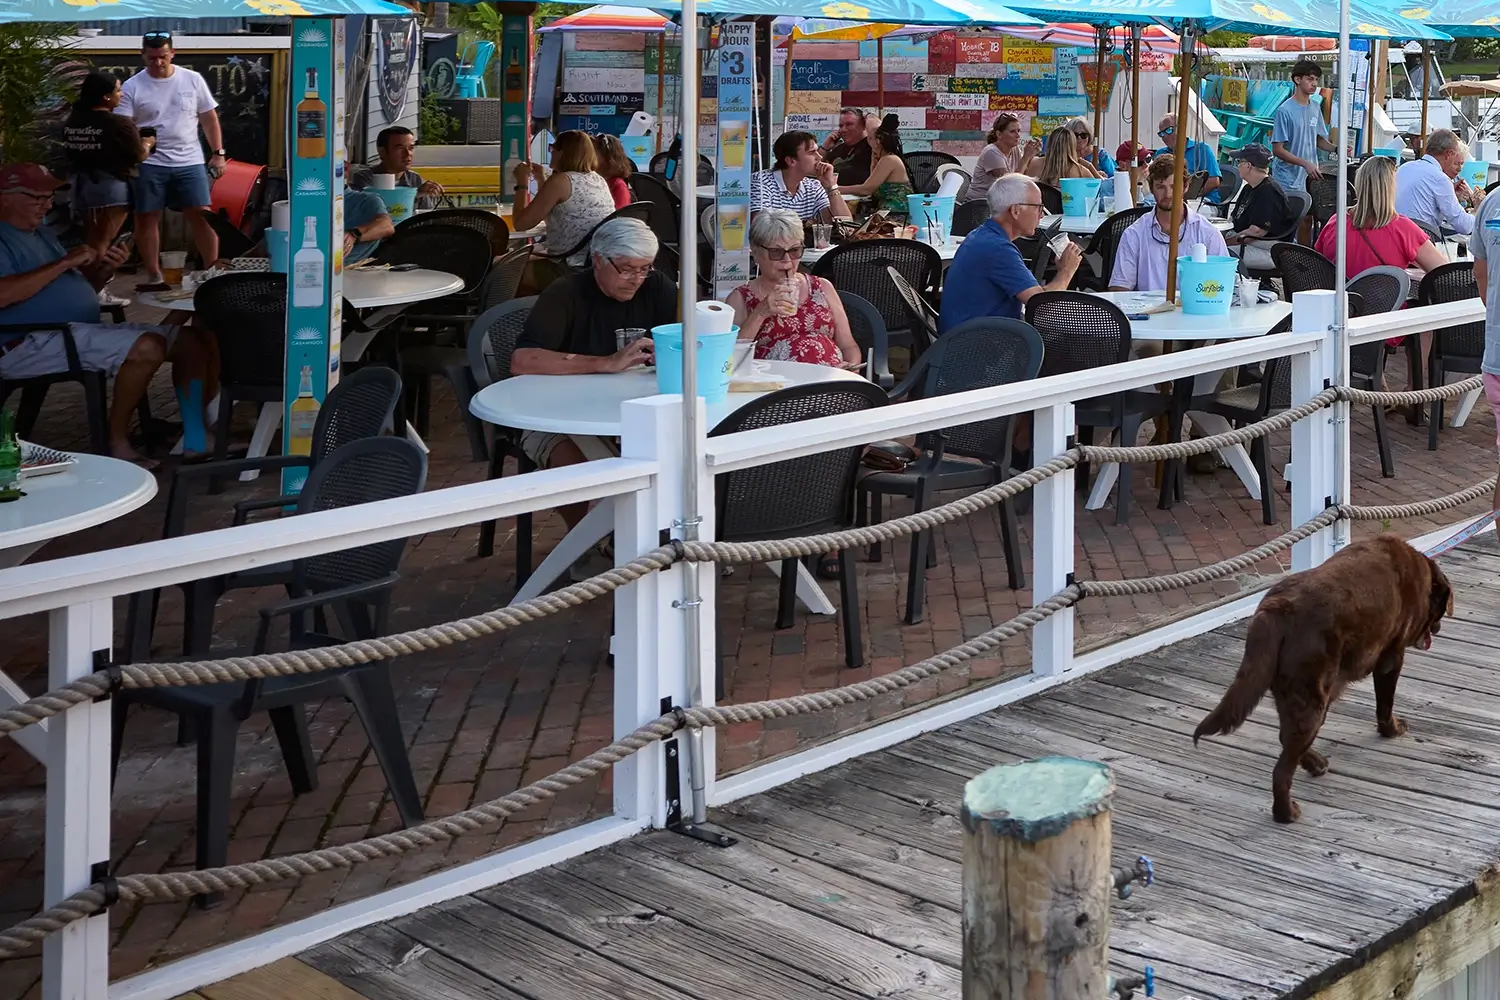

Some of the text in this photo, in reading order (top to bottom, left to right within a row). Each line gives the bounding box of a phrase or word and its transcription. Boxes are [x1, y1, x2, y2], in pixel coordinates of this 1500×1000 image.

[721, 24, 752, 35] HAPPY
[722, 36, 750, 46] HOUR
[790, 61, 822, 74] Amalfi
[208, 64, 247, 96] TO
[568, 69, 601, 80] Right
[807, 74, 832, 85] Coast
[720, 77, 751, 85] DRAFTS
[63, 126, 103, 136] Paradise
[1195, 282, 1225, 294] Surfside
